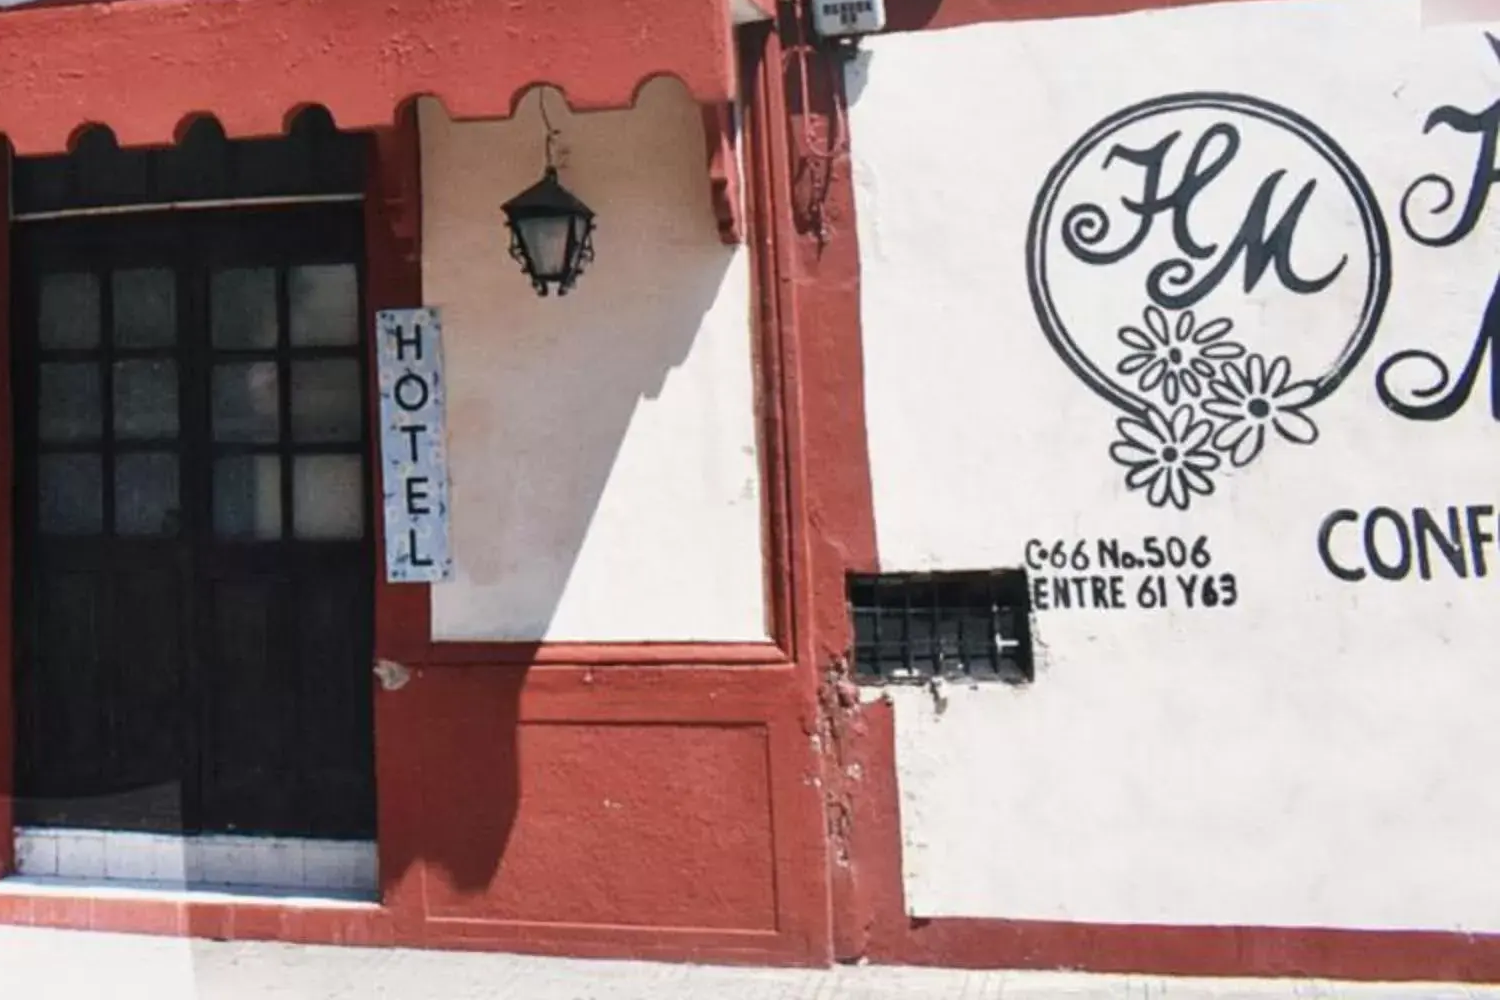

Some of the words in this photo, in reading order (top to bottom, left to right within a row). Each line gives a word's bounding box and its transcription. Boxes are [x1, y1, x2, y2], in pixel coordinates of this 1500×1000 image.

[394, 325, 432, 567] HOTEL
[1317, 504, 1500, 582] CONF
[1033, 575, 1126, 611] ENTRE
[1137, 575, 1168, 609] 61
